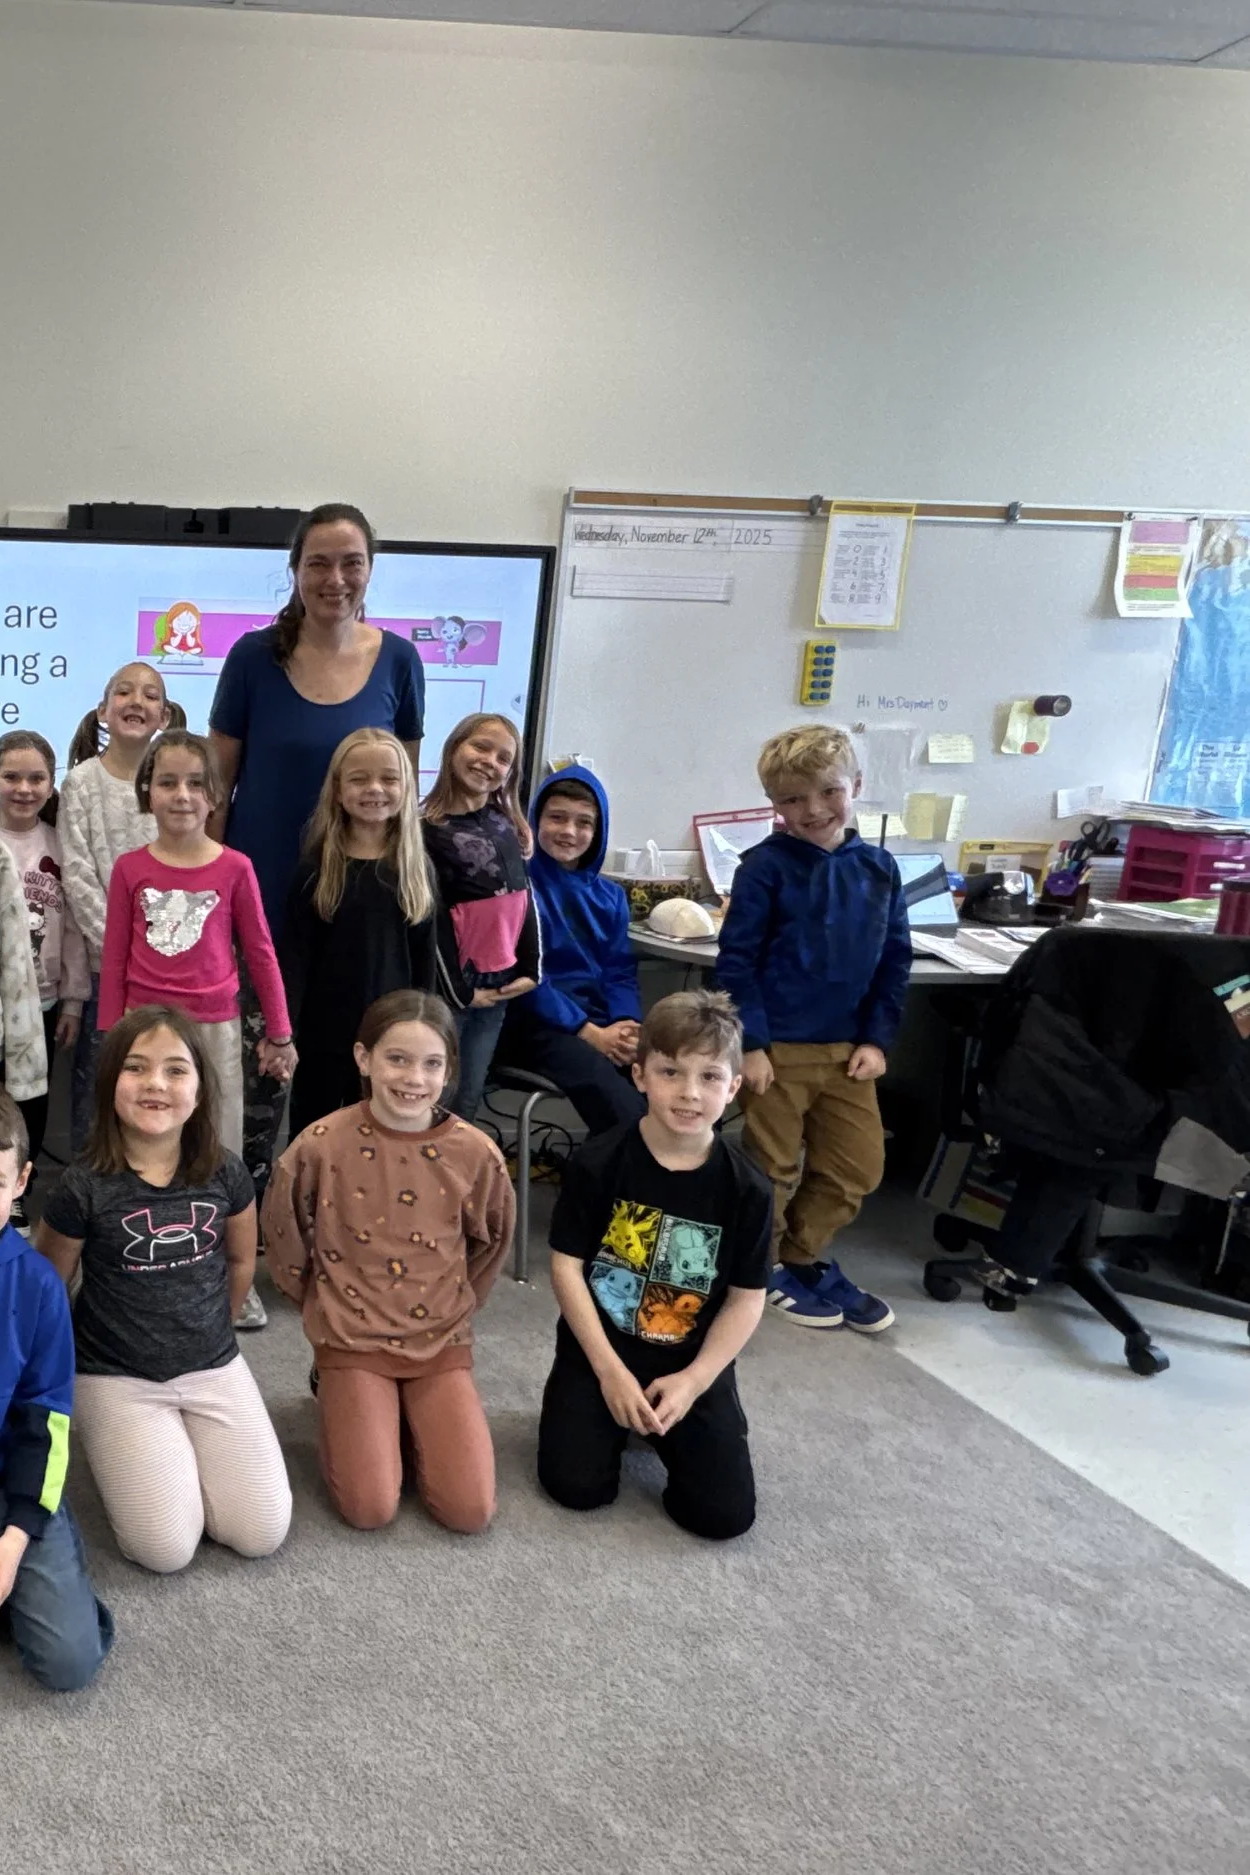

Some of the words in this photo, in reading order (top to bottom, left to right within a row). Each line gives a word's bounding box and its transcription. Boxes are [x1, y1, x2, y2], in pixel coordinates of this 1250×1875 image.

[631, 523, 689, 544] November
[734, 528, 772, 546] 2025
[4, 605, 58, 629] are
[50, 656, 68, 678] a
[857, 695, 870, 709] Hi
